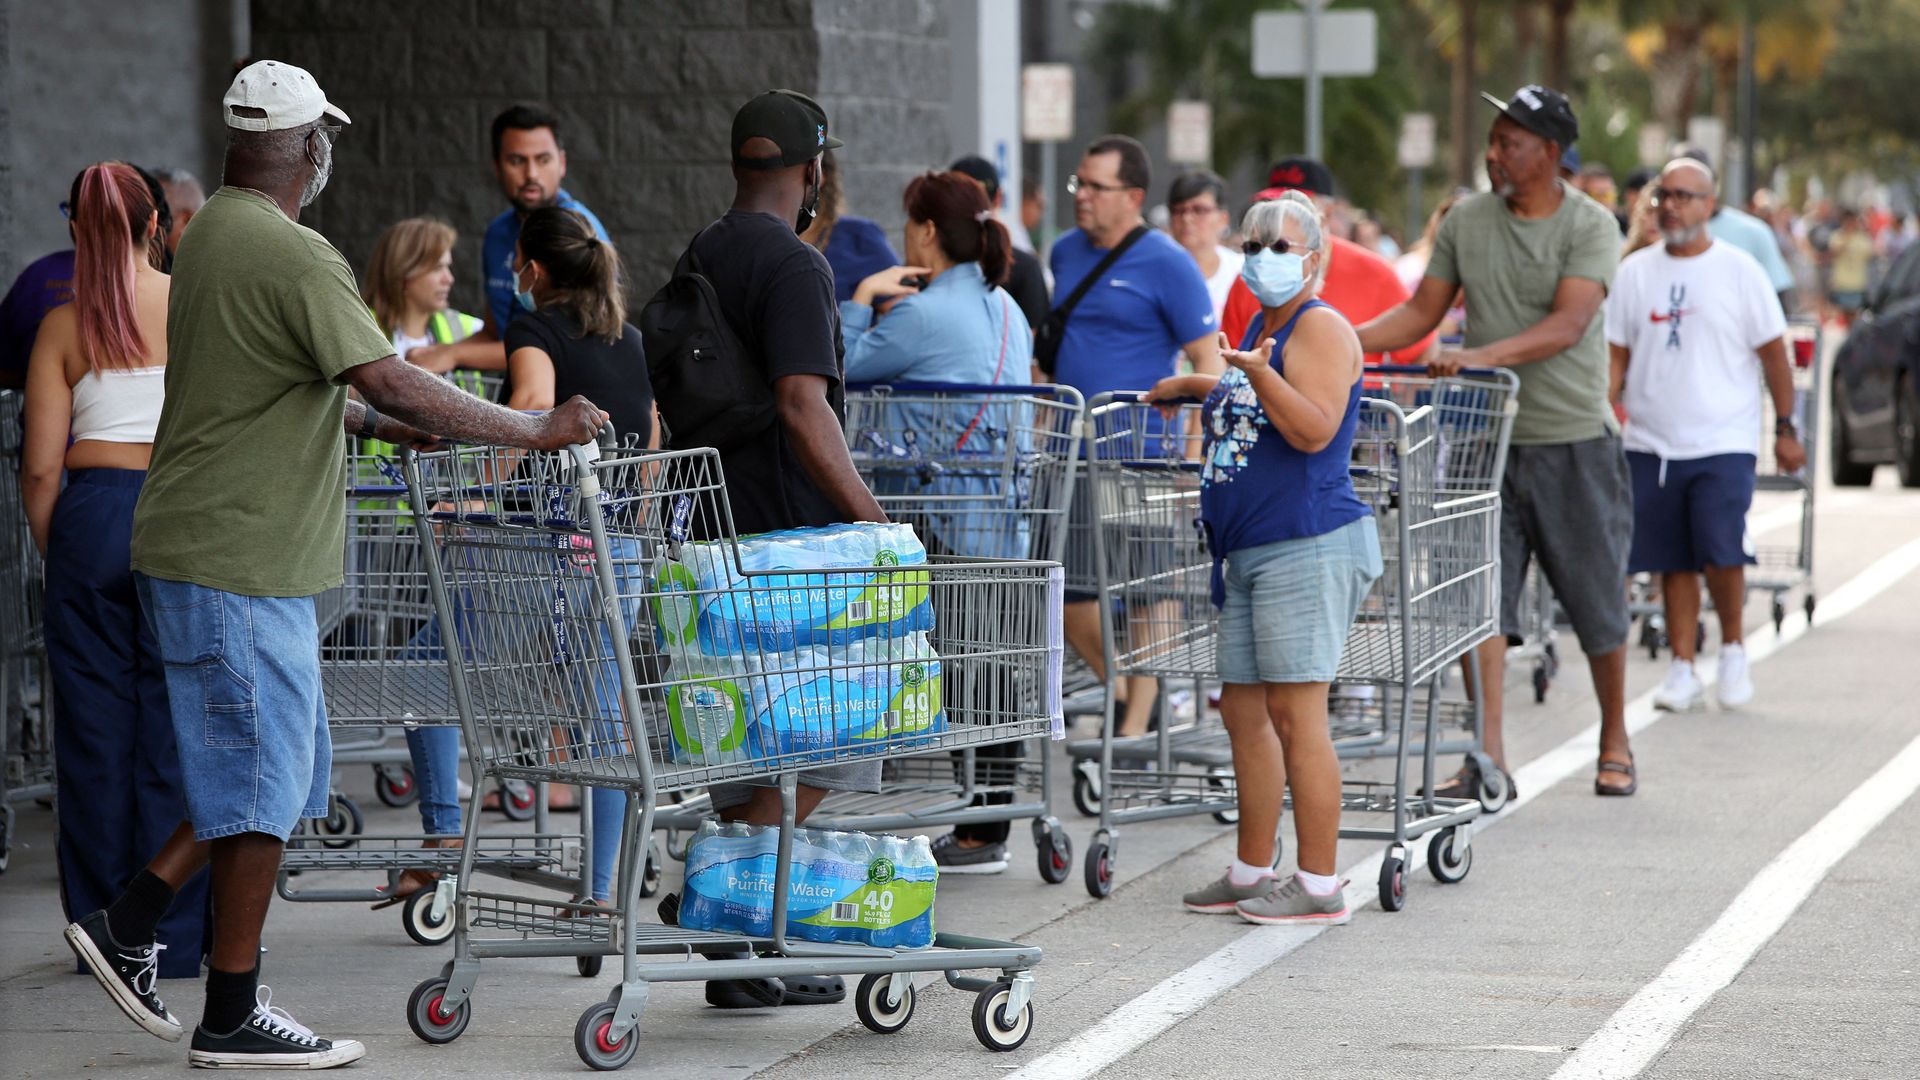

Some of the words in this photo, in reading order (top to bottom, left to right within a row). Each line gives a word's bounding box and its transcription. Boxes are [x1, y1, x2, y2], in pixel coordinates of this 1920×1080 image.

[1666, 283, 1686, 350] USA
[743, 591, 802, 609] Purified
[806, 589, 848, 603] Water
[874, 586, 904, 603] 40
[789, 702, 841, 719] Purified
[844, 698, 882, 712] Water
[903, 692, 929, 713] 40
[727, 876, 777, 893] Purifie
[791, 882, 836, 898] Water
[863, 890, 894, 912] 40
